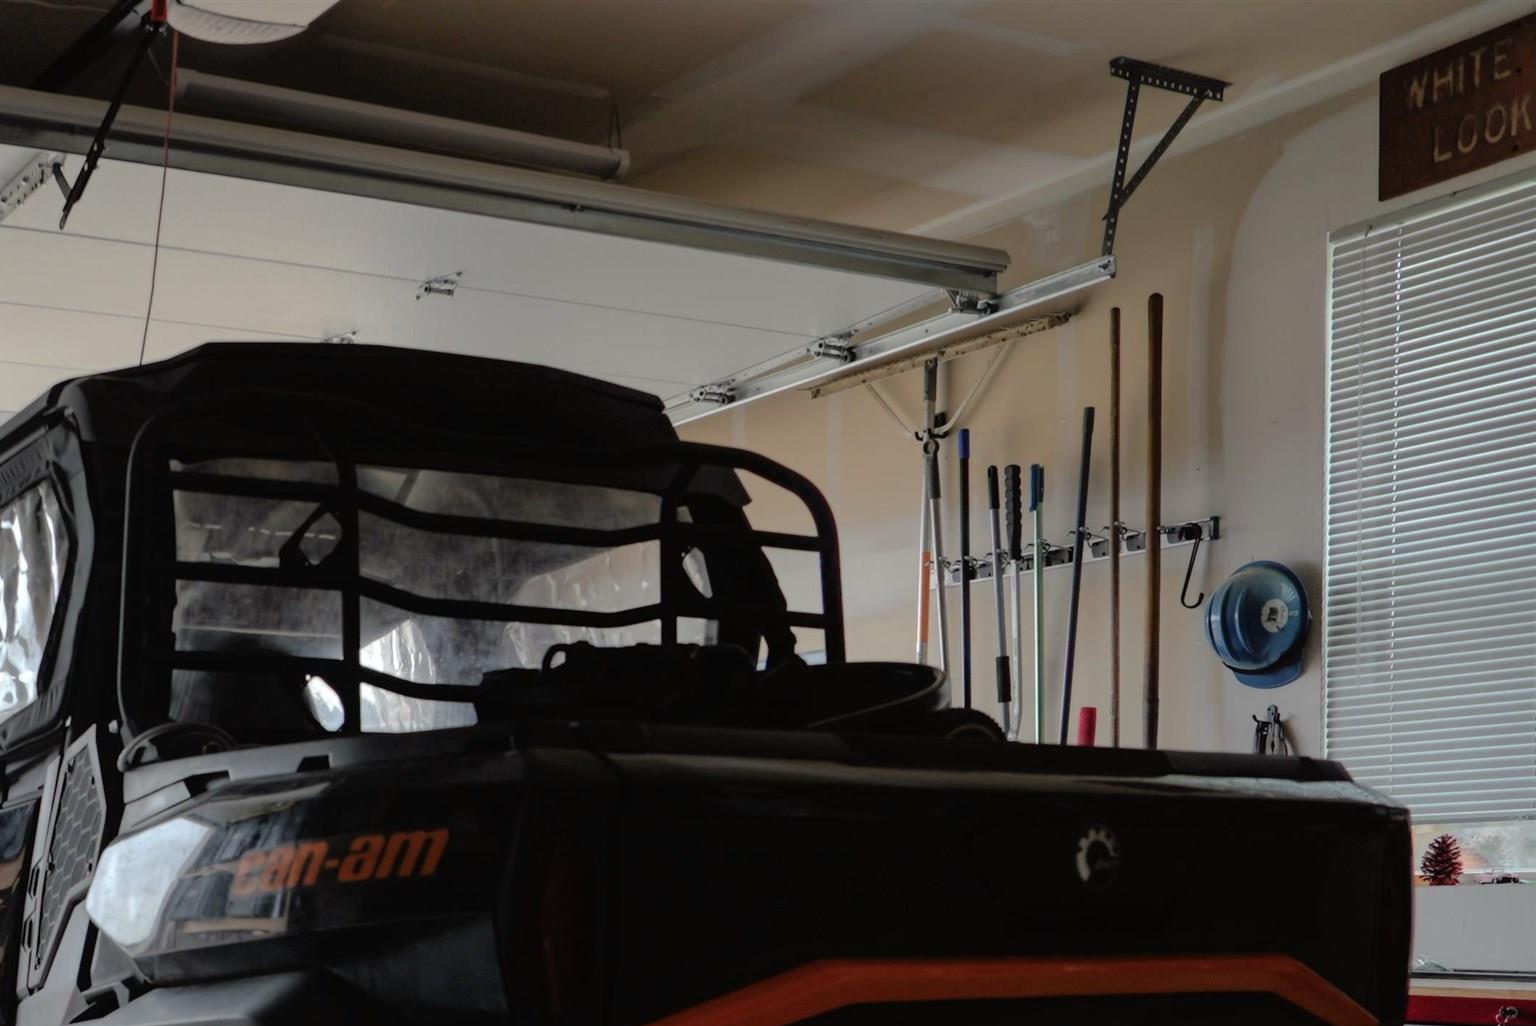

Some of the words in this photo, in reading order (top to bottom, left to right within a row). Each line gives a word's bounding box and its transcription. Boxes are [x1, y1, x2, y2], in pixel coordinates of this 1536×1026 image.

[1403, 38, 1513, 109] WHITE
[1433, 95, 1532, 163] LOOK
[233, 828, 449, 896] can-am
